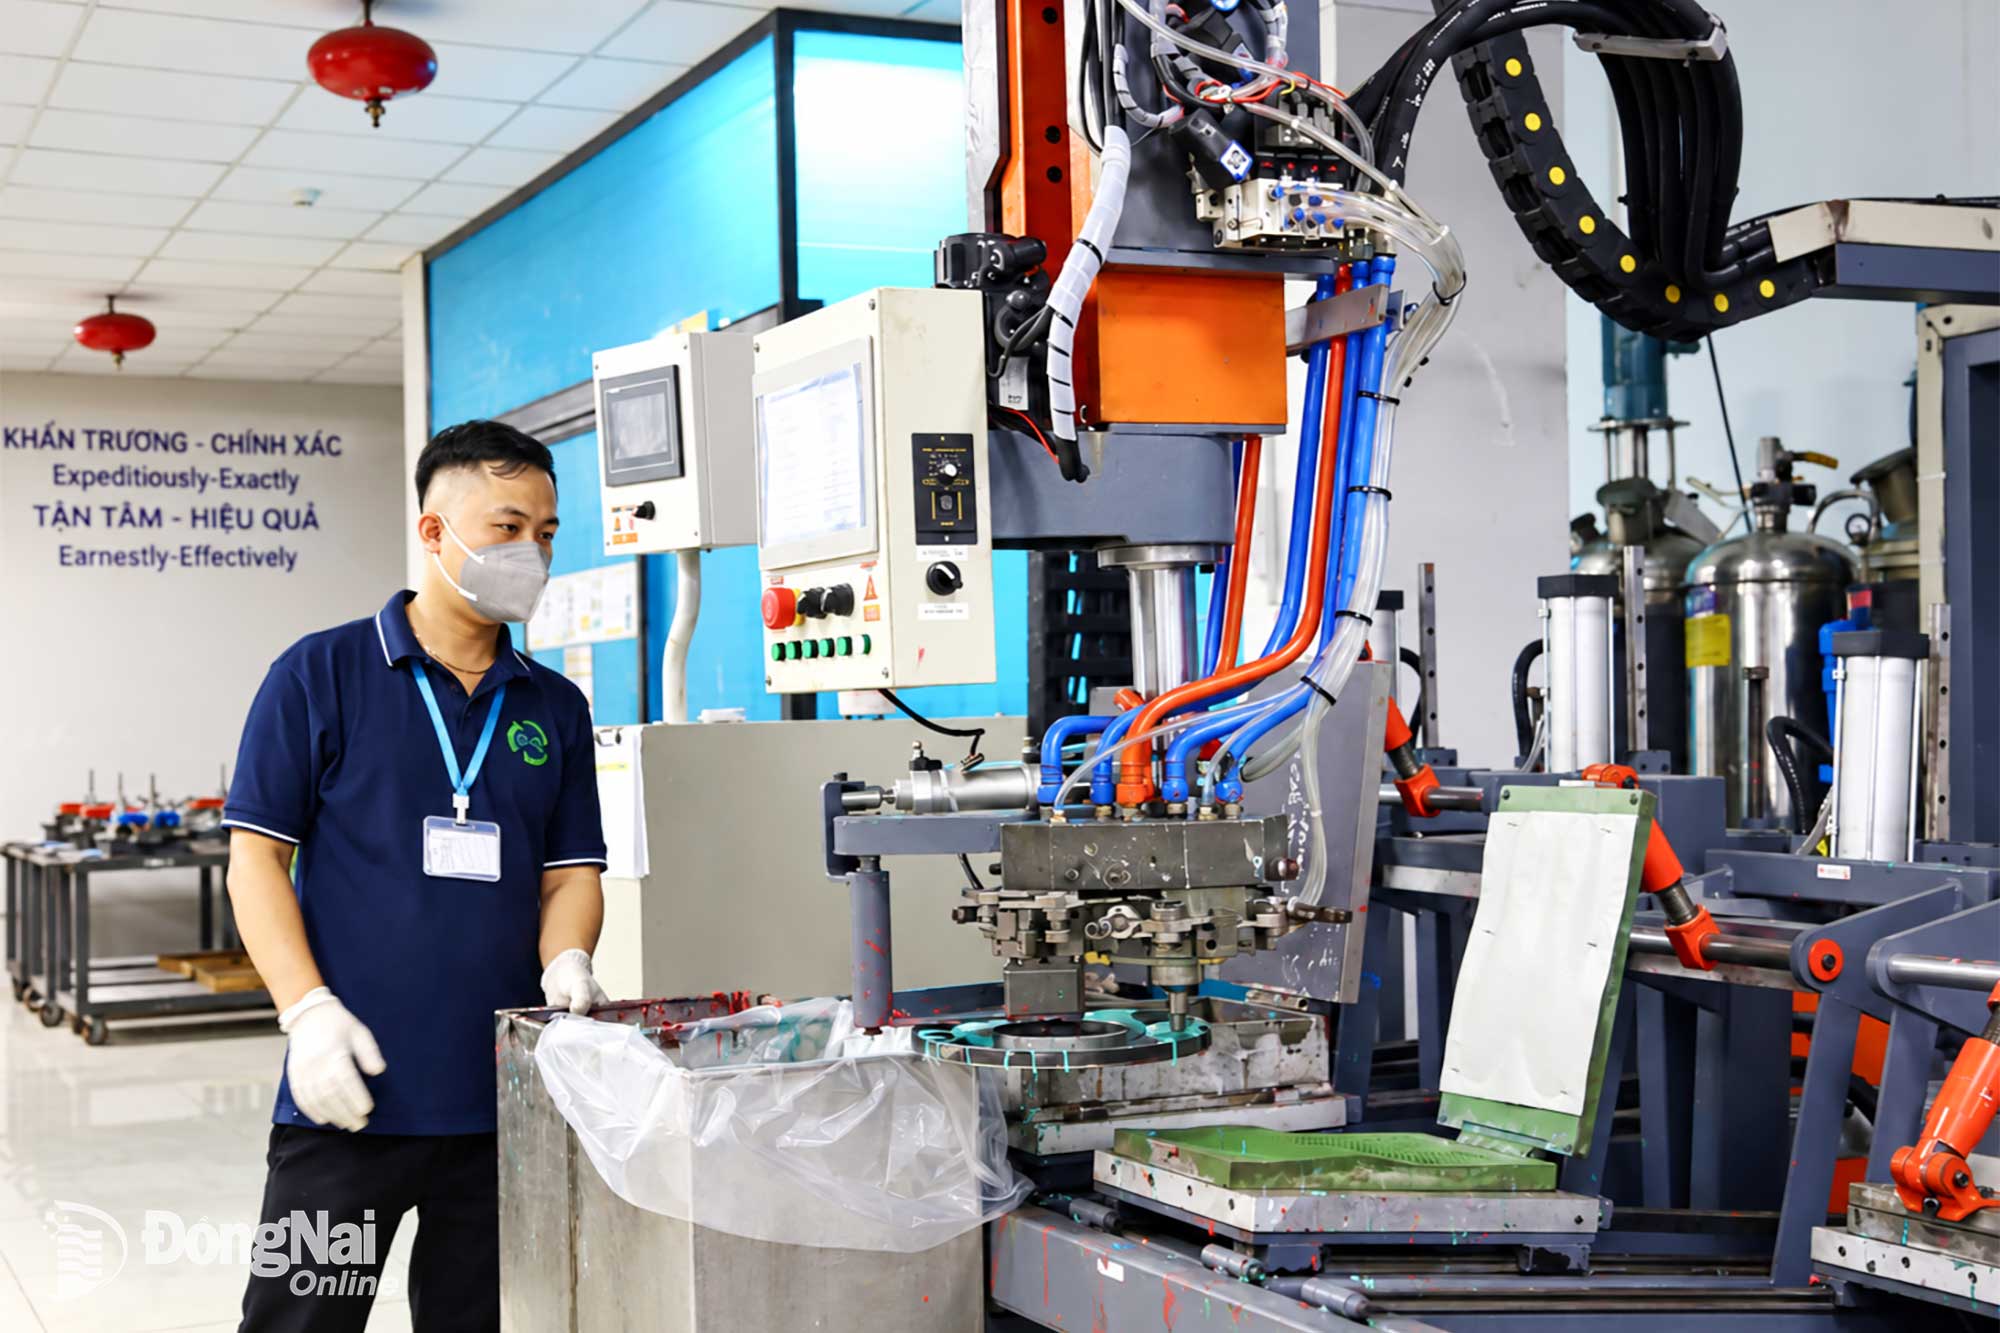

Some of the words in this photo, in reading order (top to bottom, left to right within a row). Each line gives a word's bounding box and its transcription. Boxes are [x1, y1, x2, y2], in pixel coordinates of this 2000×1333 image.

[82, 427, 188, 453] TRƯƠNG
[211, 428, 286, 455] CHÍNH
[294, 429, 342, 457] XÁC
[53, 464, 300, 496] Expeditiously-Exactly
[33, 500, 91, 532] TẬN
[100, 501, 162, 528] TÂM
[191, 502, 253, 534] HIỆU
[262, 501, 320, 532] QUẢ
[60, 544, 297, 573] Earnestly-Effectively
